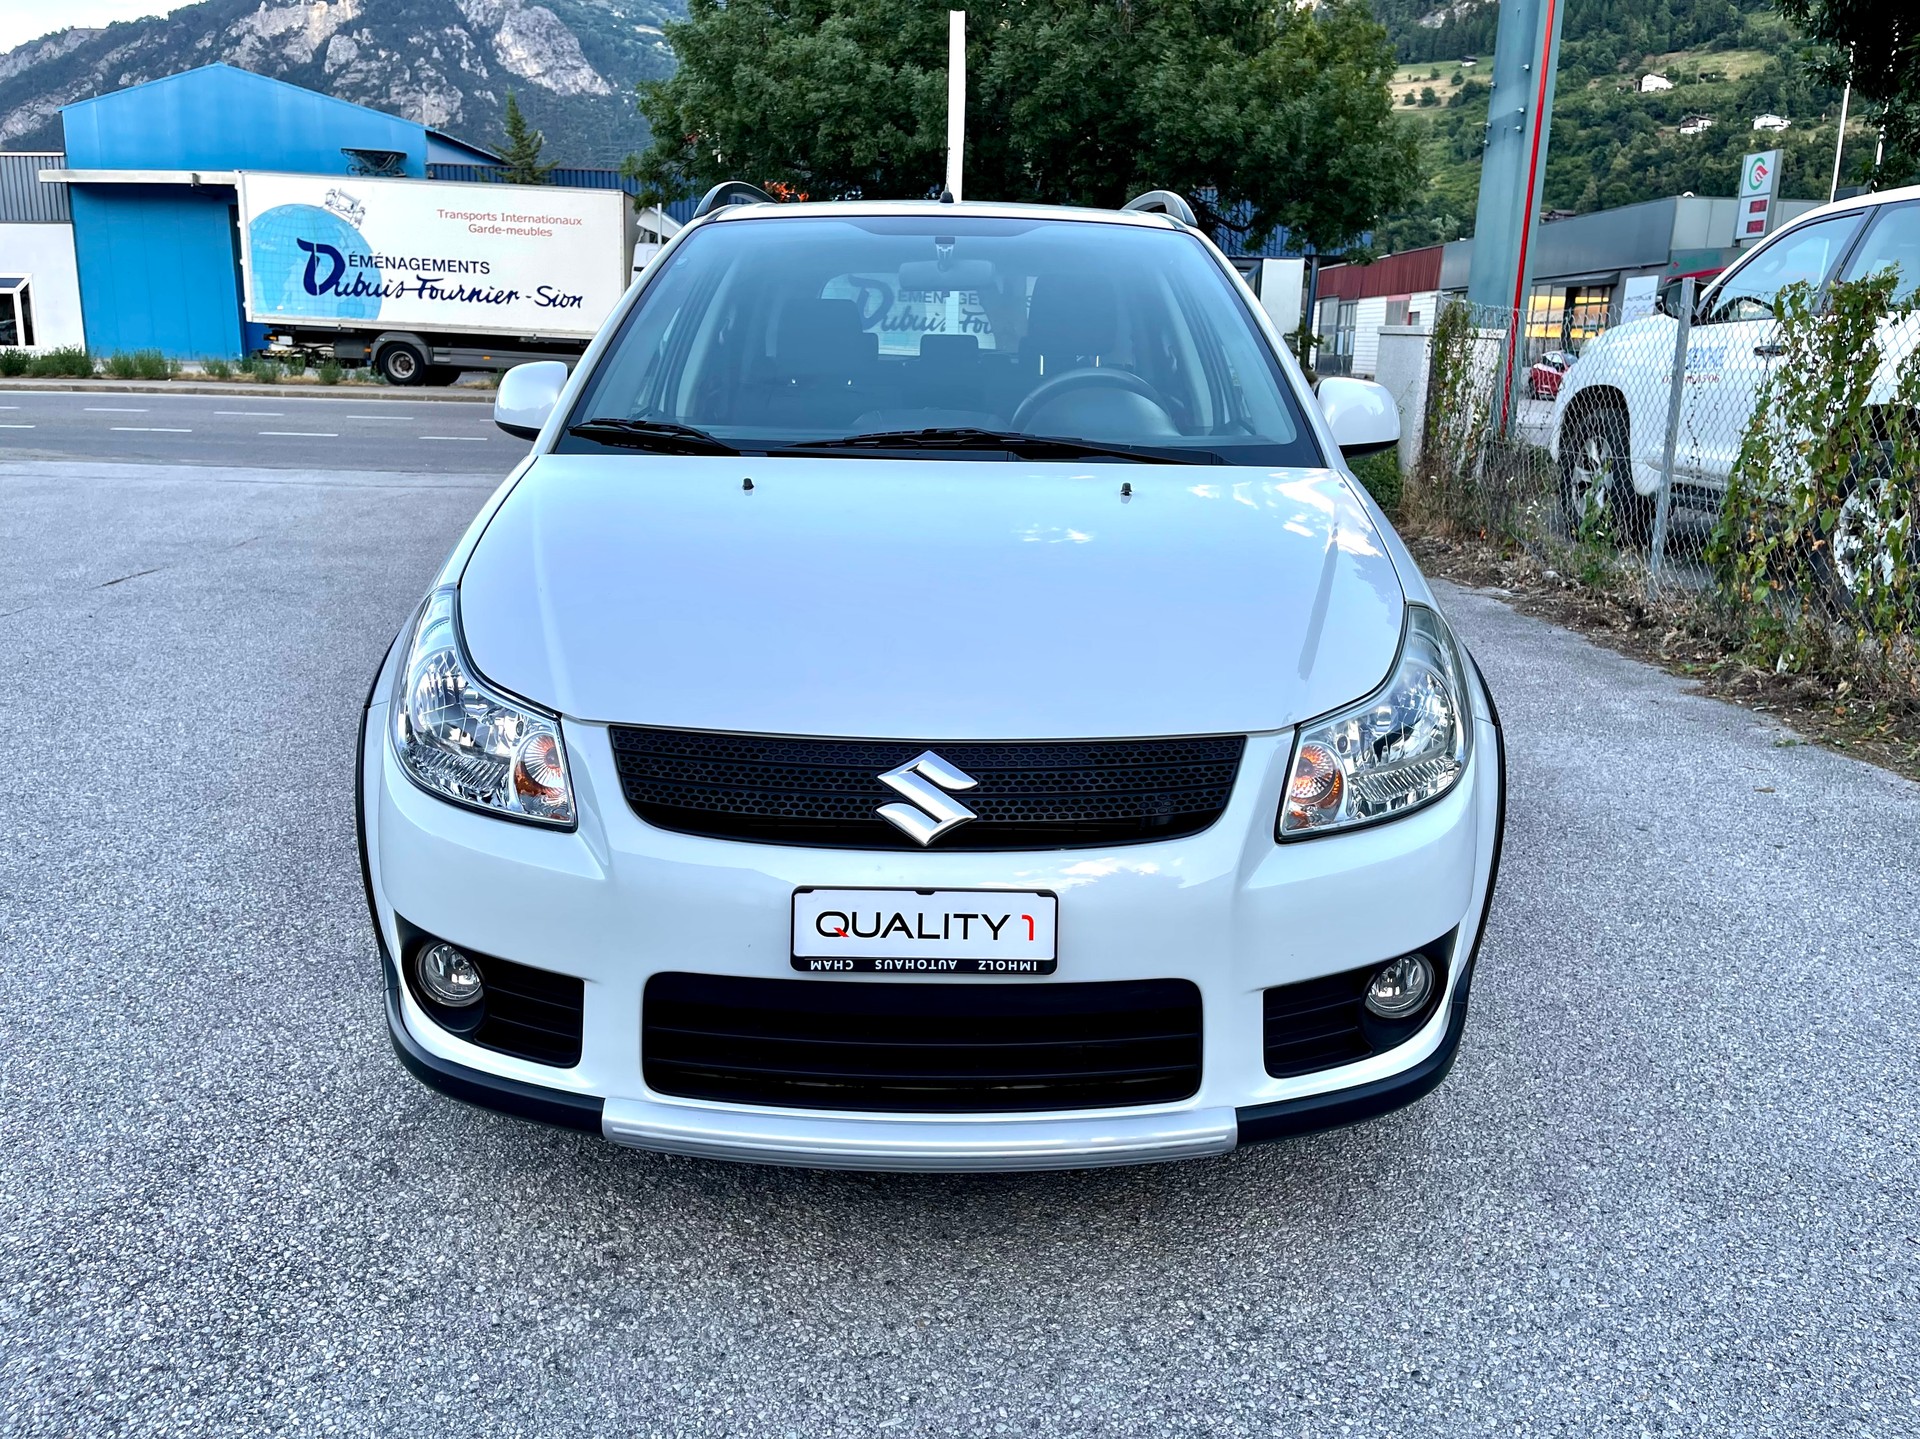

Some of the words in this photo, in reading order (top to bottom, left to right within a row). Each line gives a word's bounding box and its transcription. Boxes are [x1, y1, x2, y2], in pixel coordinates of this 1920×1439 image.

[436, 208, 498, 222] Transports
[501, 212, 582, 226] Internationaux
[468, 223, 553, 237] Garde-meubles
[534, 285, 584, 309] Sion
[815, 910, 1012, 941] QUALITY
[1021, 914, 1035, 941] 1
[810, 960, 855, 970] CHAM
[875, 959, 958, 971] AUTOHAUS
[977, 960, 1038, 972] IMHOLZ
